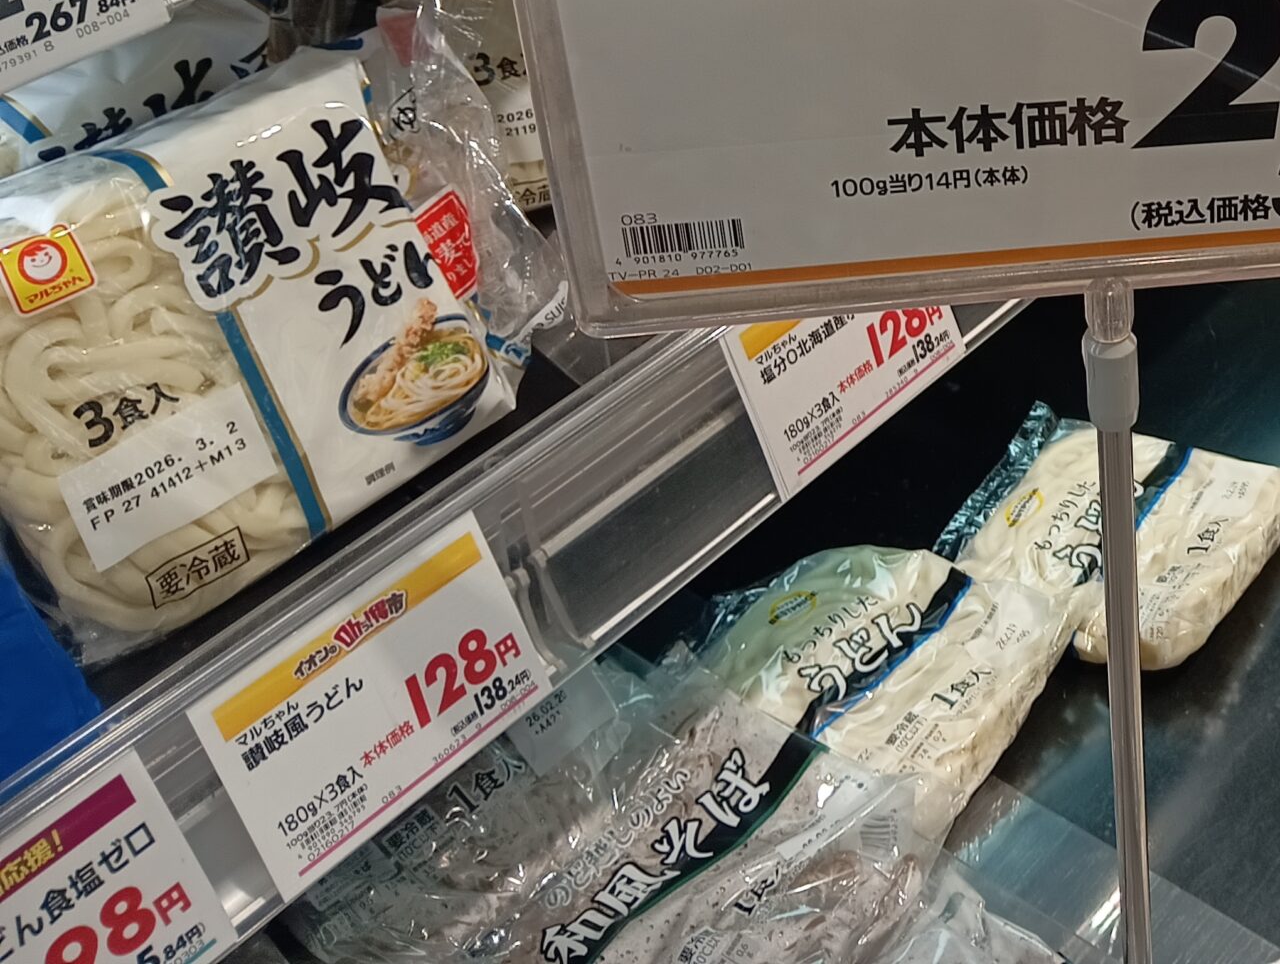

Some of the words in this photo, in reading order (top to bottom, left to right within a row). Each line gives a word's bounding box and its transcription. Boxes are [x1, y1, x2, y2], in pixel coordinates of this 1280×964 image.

[886, 95, 1130, 159] 本体価格
[160, 118, 410, 297] 讃岐
[830, 164, 1030, 199] 100g当り14円(本体)
[621, 212, 658, 226] 083
[608, 268, 658, 282] TV-PR
[663, 268, 680, 278] 24
[633, 252, 683, 265] 901810
[690, 248, 739, 261] 977765
[754, 332, 799, 366] マルちゃん
[866, 306, 945, 368] 128円
[73, 381, 180, 449] 3食入
[122, 494, 142, 514] 27
[154, 537, 241, 599] 要冷蔵
[784, 593, 880, 664] もっちりした
[797, 602, 925, 703] うどん
[234, 700, 300, 748] マルちゃん
[240, 676, 364, 773] 讃岐風うどん
[359, 719, 416, 769] 本体価格
[404, 628, 522, 730] 128円
